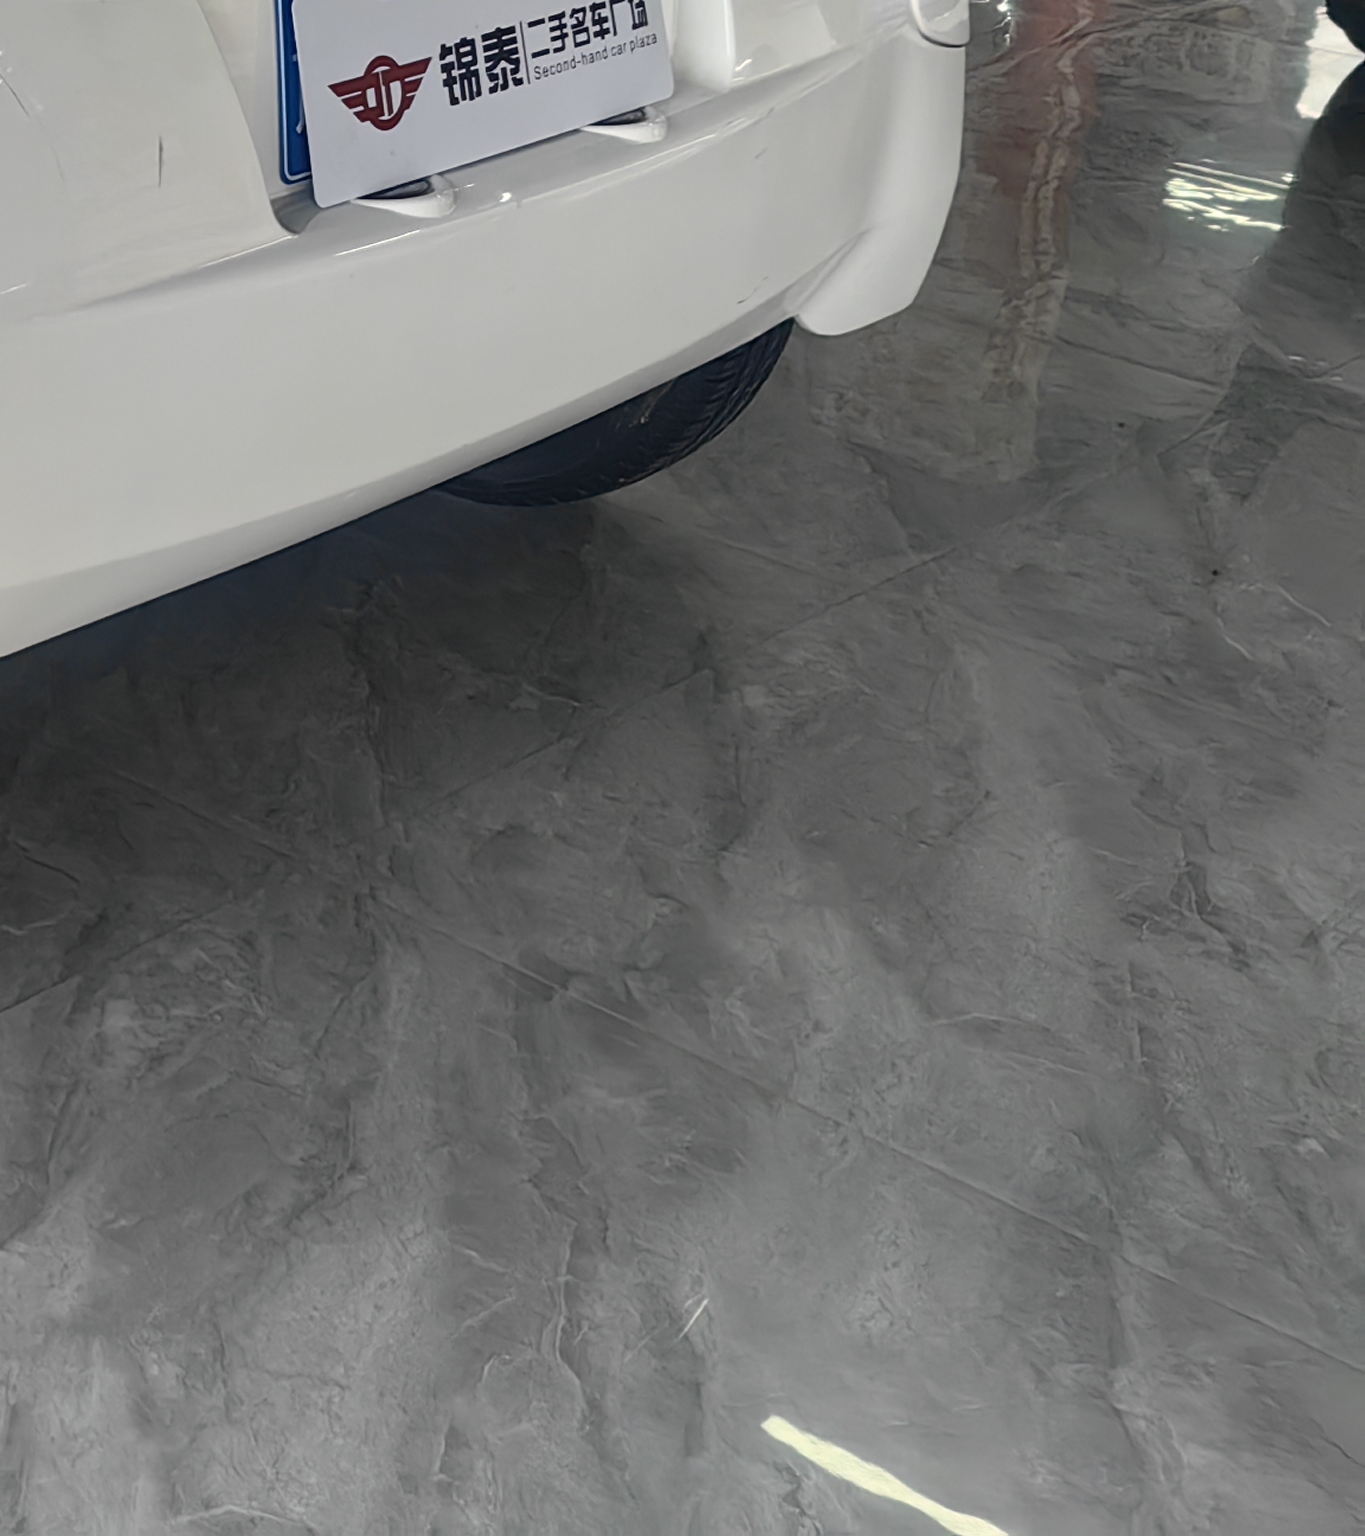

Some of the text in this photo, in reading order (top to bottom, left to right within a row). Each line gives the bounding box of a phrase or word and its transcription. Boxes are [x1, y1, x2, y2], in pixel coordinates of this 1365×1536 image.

[438, 25, 525, 106] 锦泰
[532, 31, 658, 81] Second-hand car plaza
